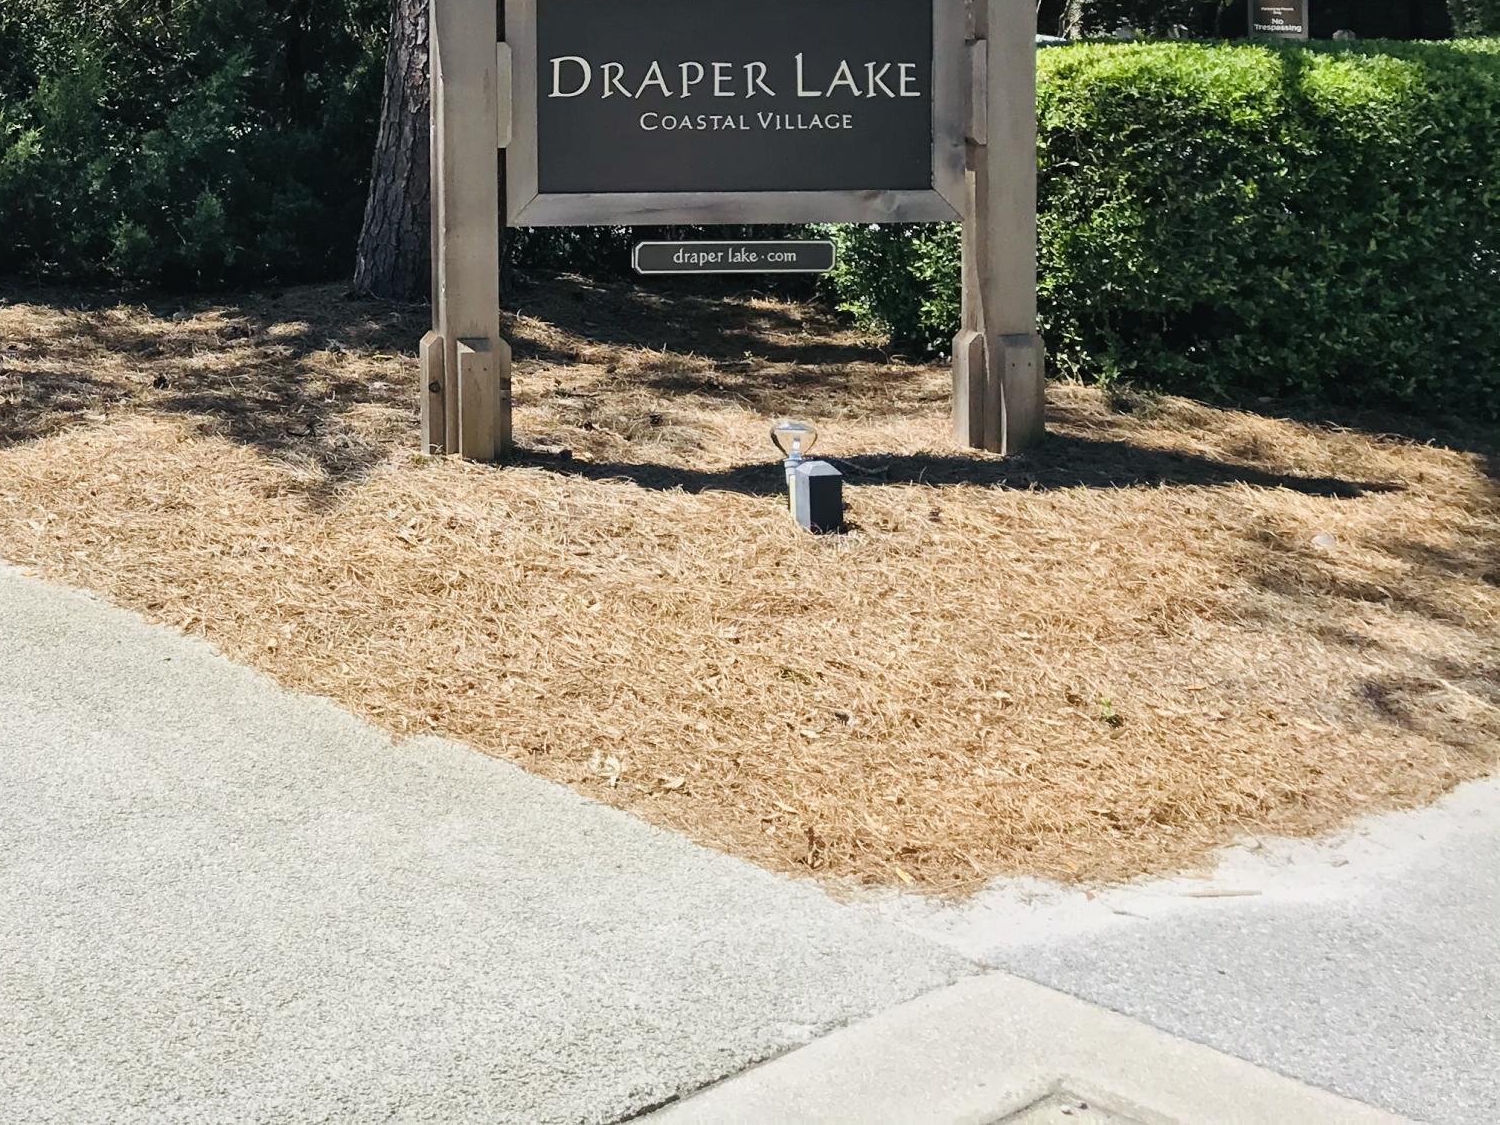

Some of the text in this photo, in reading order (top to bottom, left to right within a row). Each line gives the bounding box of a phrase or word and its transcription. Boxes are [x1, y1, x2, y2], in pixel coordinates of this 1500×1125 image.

[1254, 23, 1302, 32] Trespassing
[548, 52, 921, 98] DRAPER LAKE
[640, 111, 853, 131] COASTAL VILLAGE
[673, 247, 724, 267] draper
